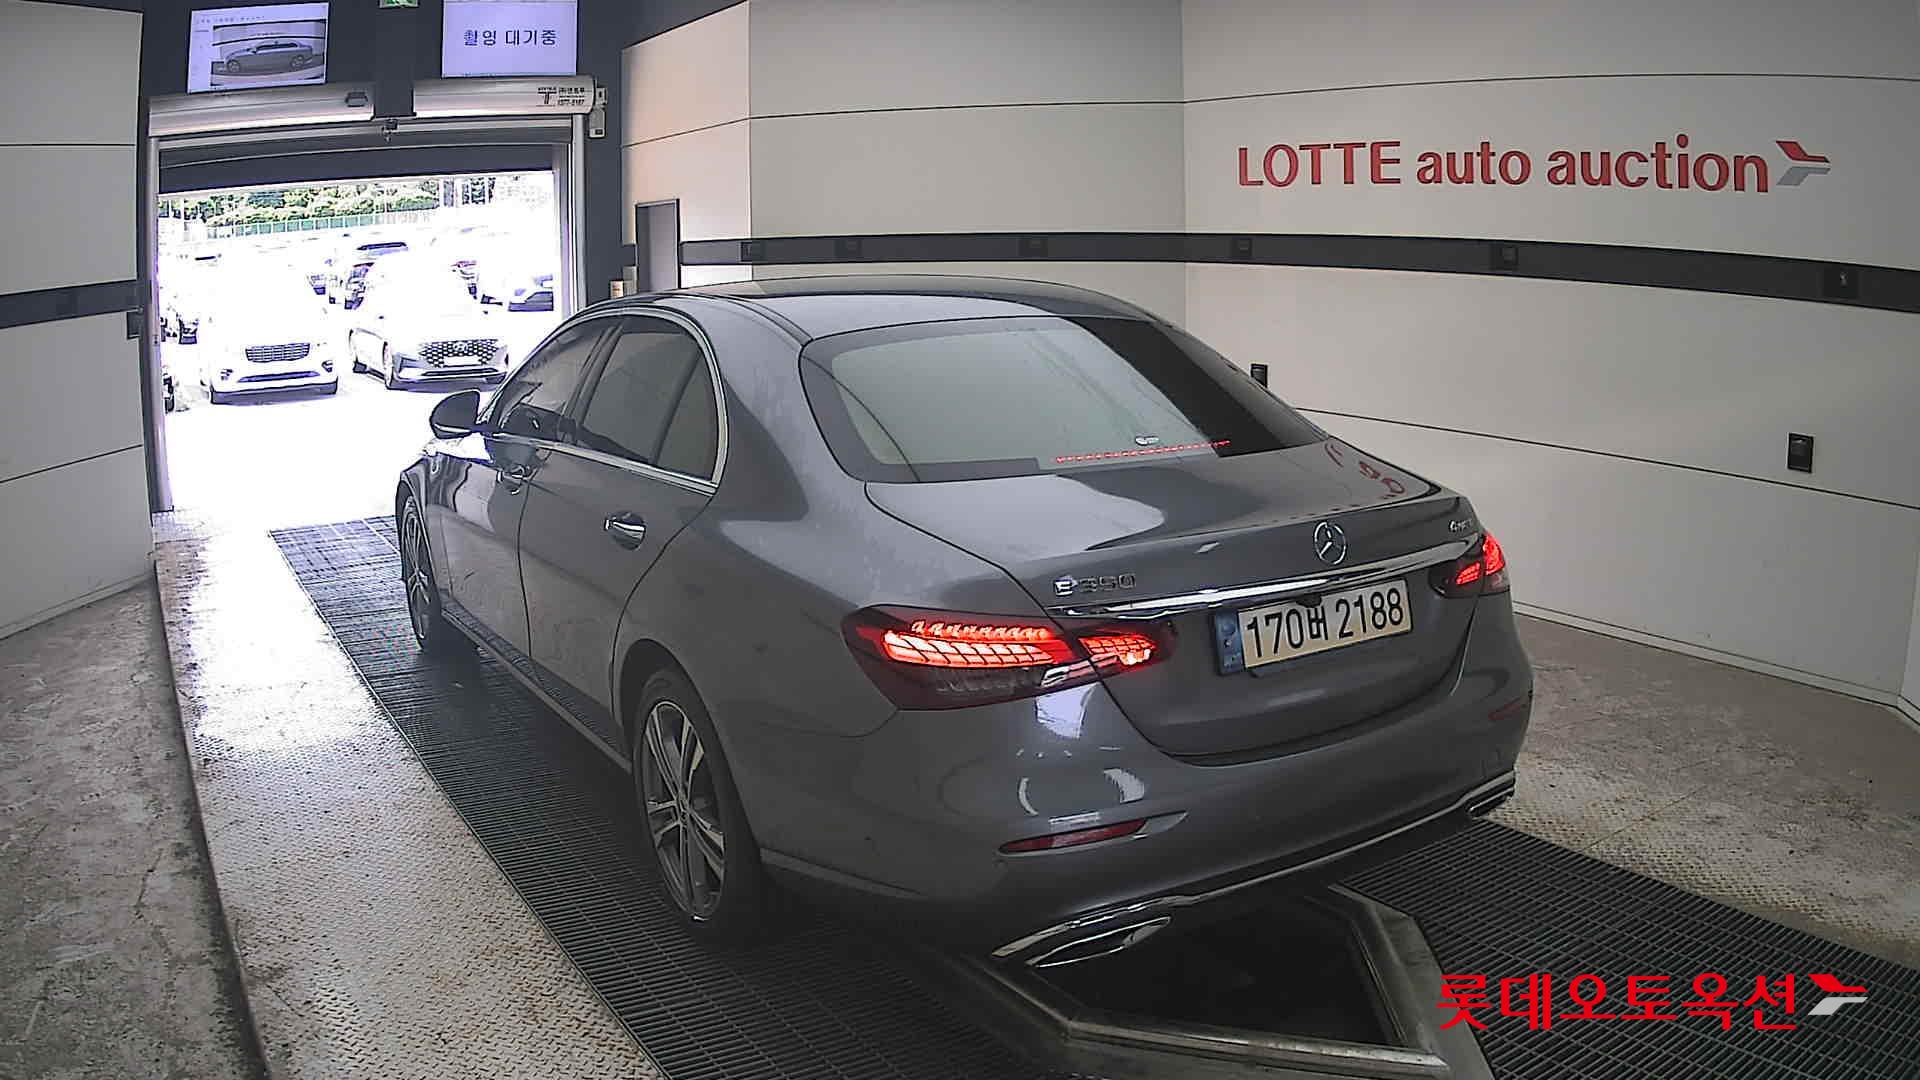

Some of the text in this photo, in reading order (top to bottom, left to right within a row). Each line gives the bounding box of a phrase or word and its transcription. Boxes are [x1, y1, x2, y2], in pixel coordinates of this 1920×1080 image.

[505, 29, 557, 46] 대기중
[1239, 134, 1768, 193] LOTTE auto auction
[1247, 588, 1404, 658] 170버 2188
